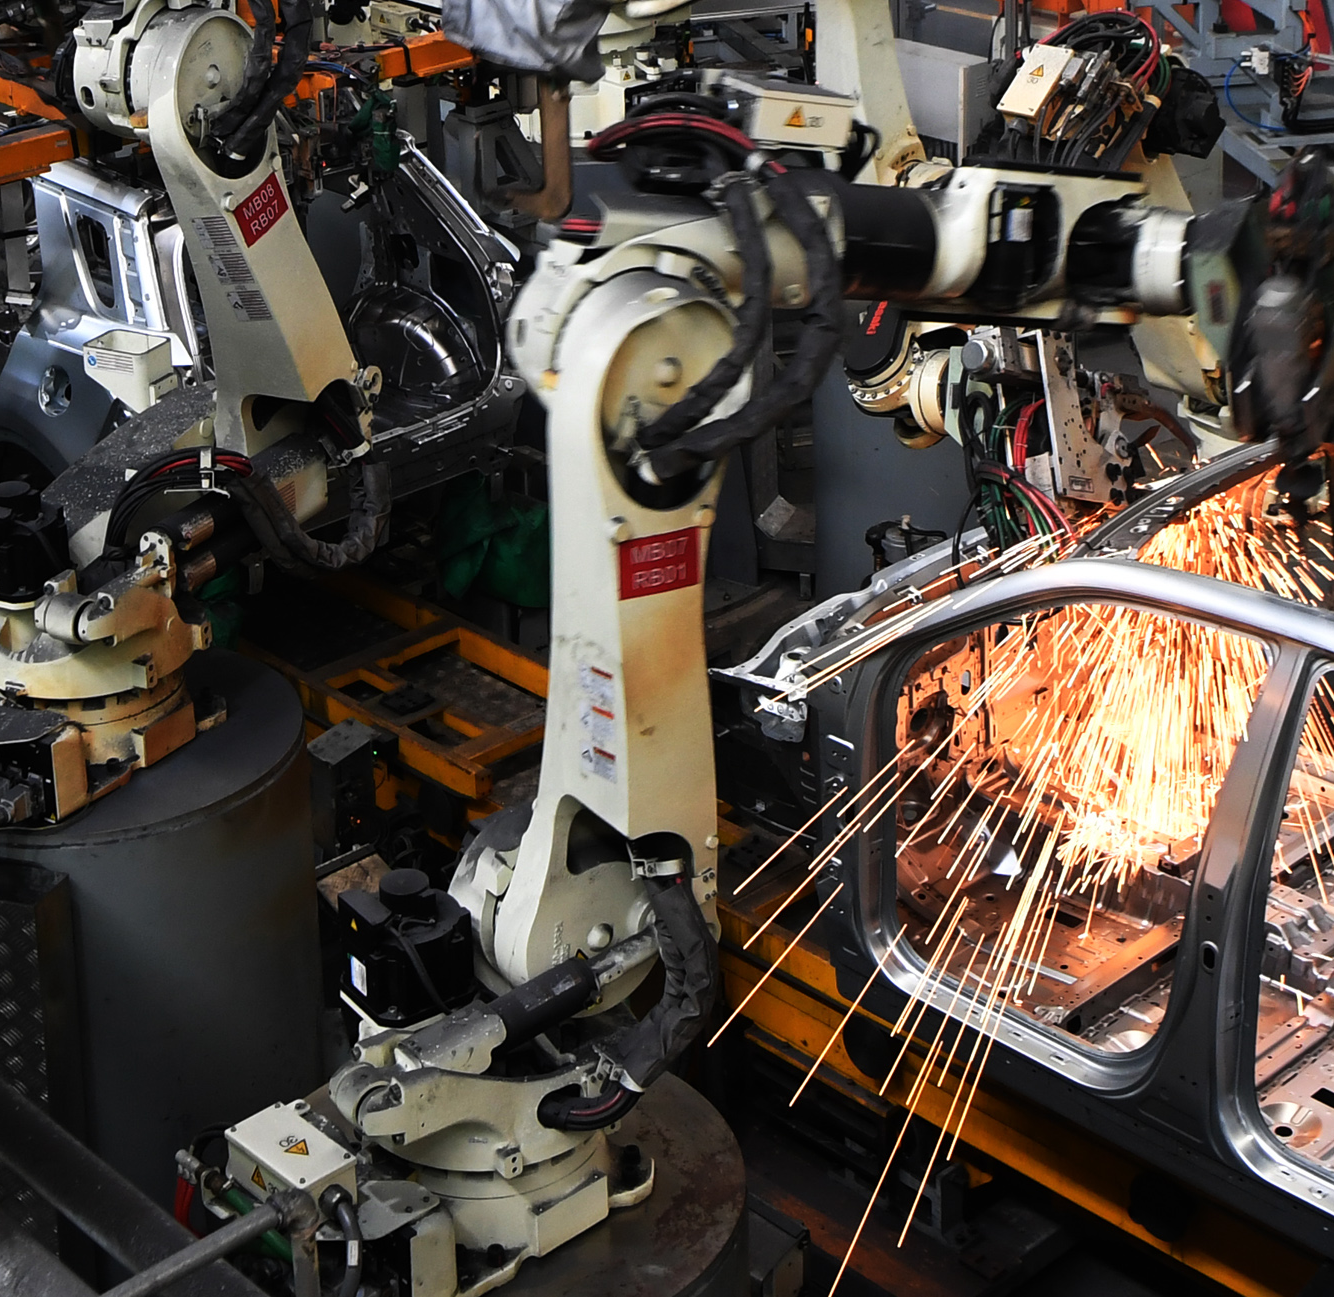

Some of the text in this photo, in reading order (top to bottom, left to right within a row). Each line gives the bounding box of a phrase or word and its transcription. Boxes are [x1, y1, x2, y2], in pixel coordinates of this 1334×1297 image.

[242, 183, 275, 220] MB08
[250, 199, 279, 236] RB07
[630, 536, 689, 565] MB07
[632, 562, 687, 590] RB01
